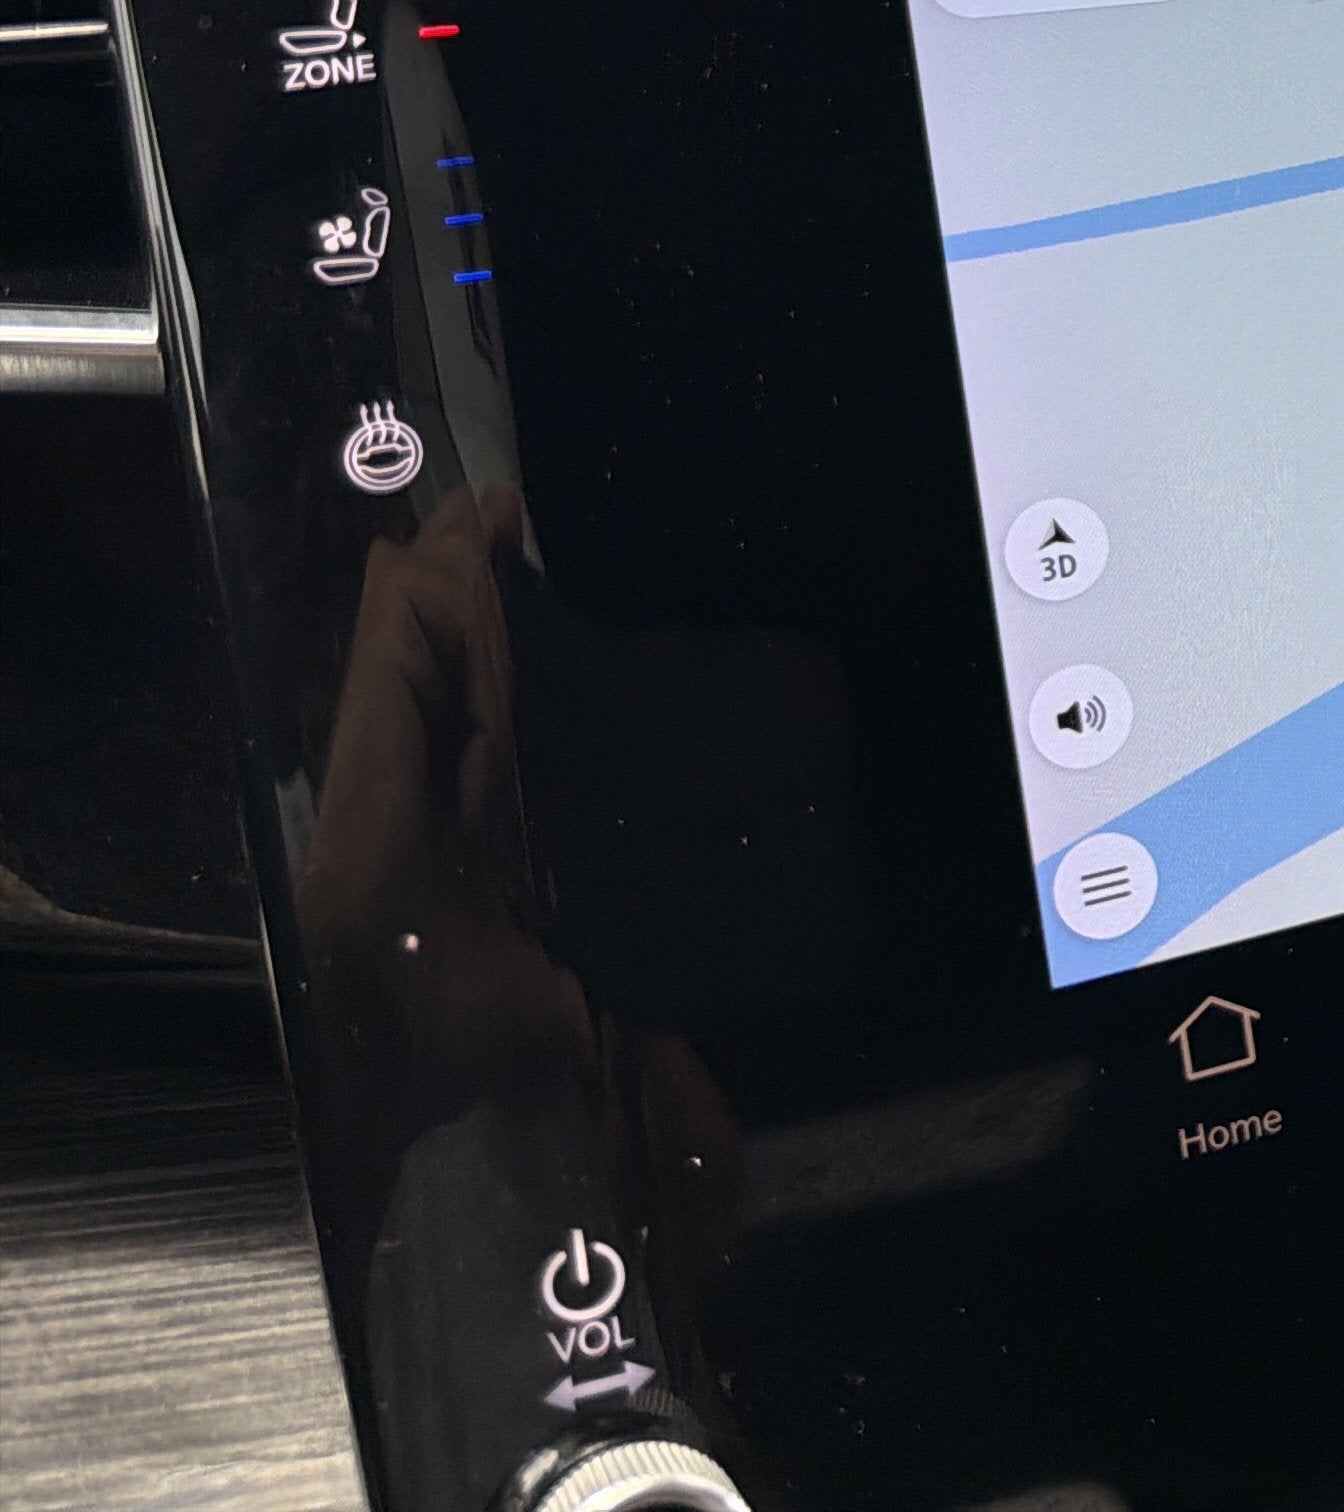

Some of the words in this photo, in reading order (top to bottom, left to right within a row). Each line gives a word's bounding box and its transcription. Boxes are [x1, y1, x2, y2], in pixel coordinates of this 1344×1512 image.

[282, 53, 377, 92] ZONE
[1041, 554, 1077, 581] 3D
[1178, 1107, 1283, 1158] Home
[547, 1316, 635, 1363] VOL
